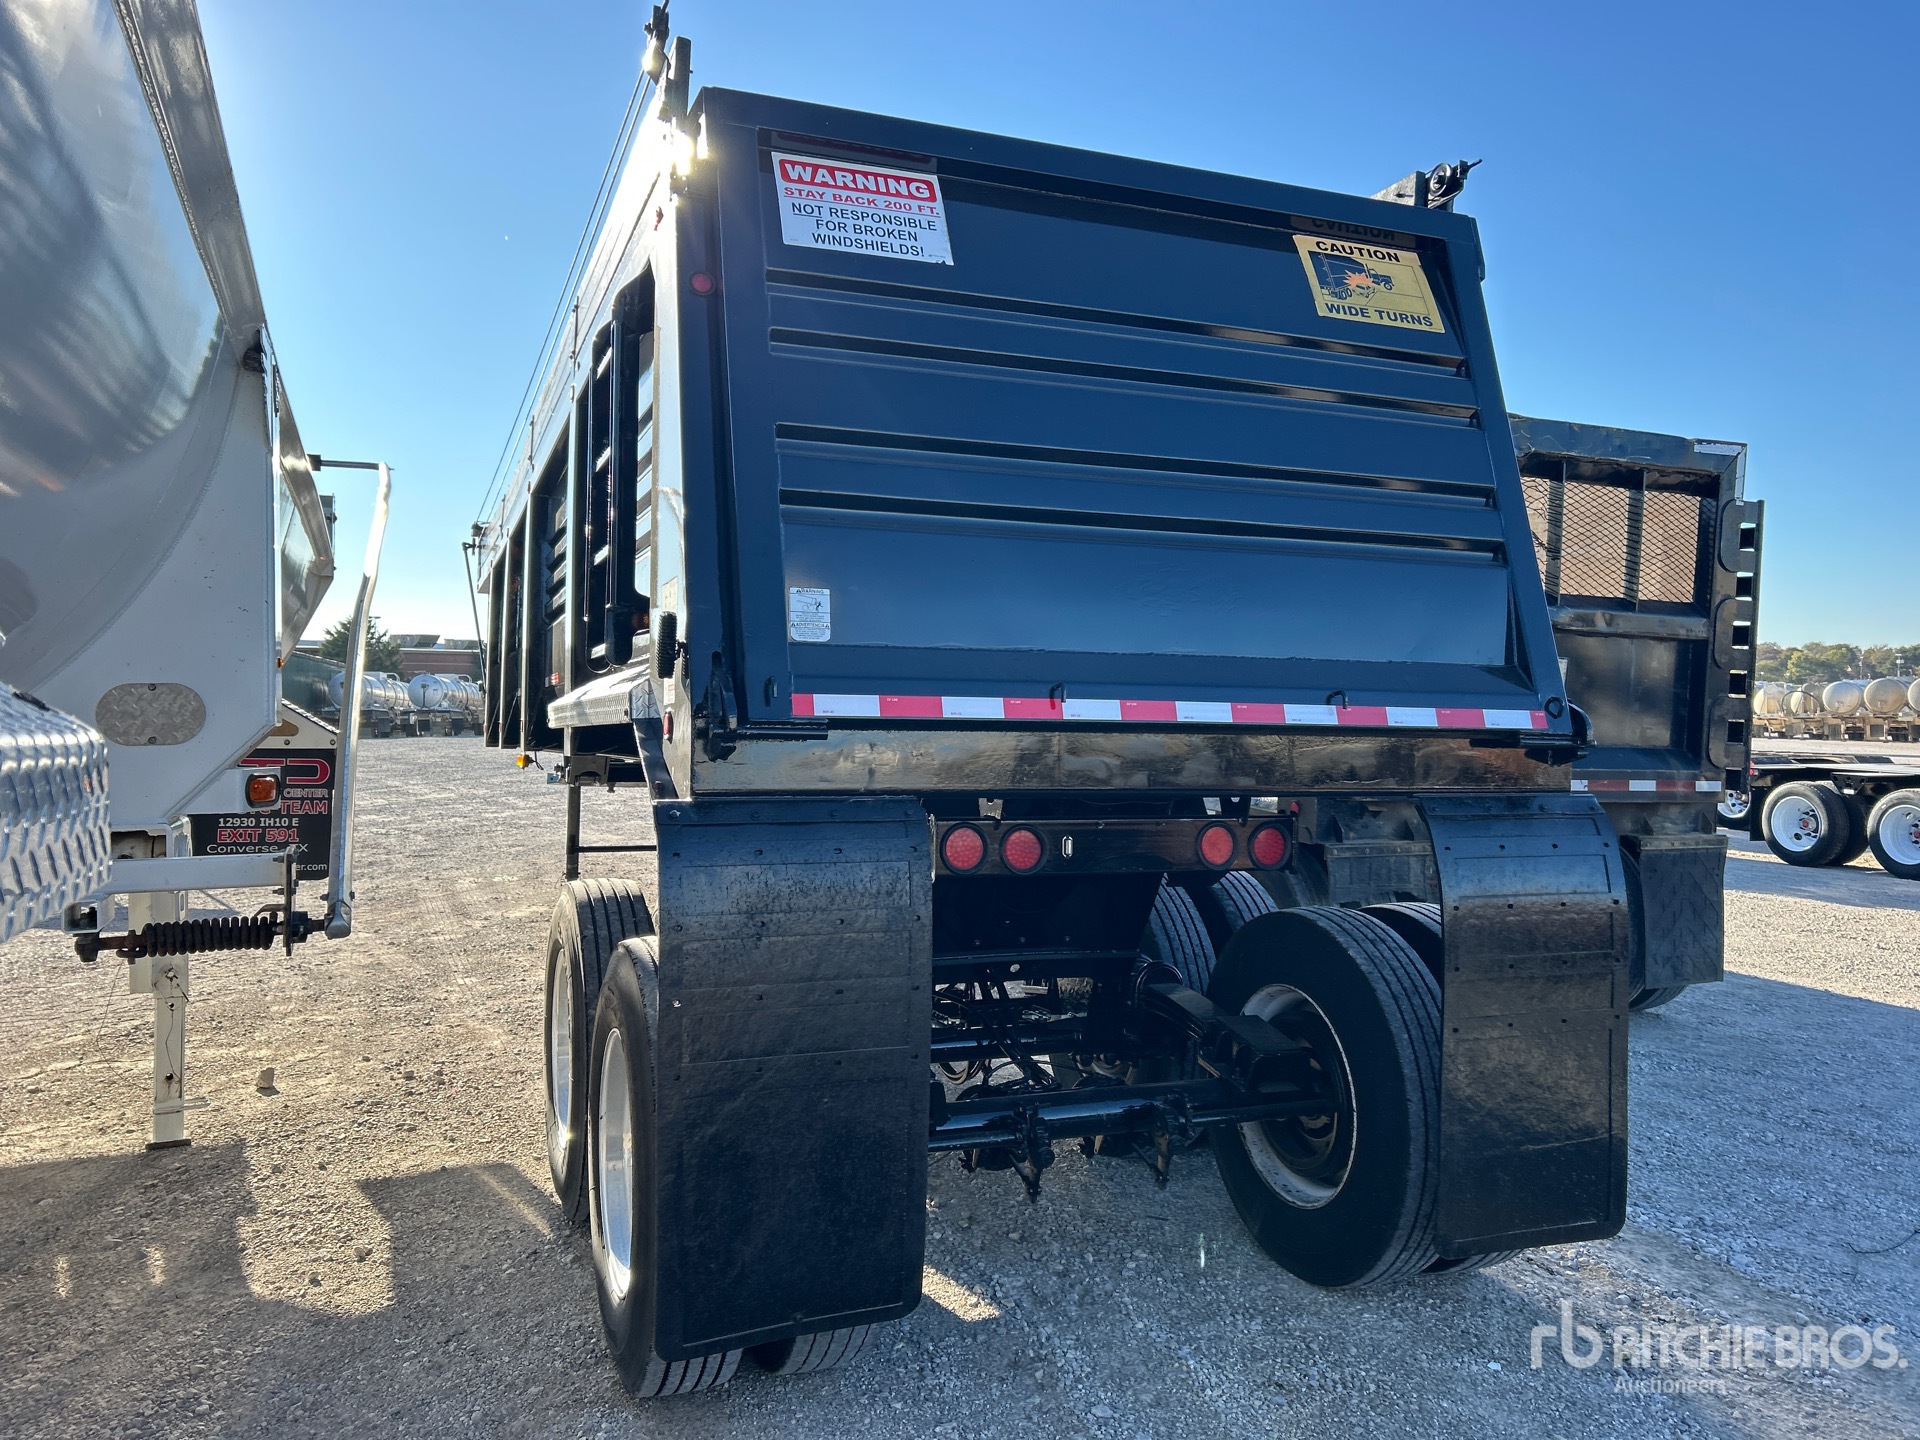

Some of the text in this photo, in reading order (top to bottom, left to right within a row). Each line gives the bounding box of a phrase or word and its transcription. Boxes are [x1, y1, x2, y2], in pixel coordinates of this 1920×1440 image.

[784, 163, 930, 199] WARNING
[784, 187, 940, 215] STAY BACK 200 FT.
[791, 202, 938, 231] NOT RESPONSIBLE
[816, 219, 918, 242] FOR BROKEN
[811, 232, 925, 257] WINDSHIELDS!
[1315, 241, 1401, 263] CAUTION
[1325, 302, 1434, 327] WIDE TURNS
[283, 788, 329, 798] CENTER
[280, 800, 328, 815] TEAM
[218, 817, 299, 827] 12930 IH10 E
[217, 828, 299, 843] EXIT 591
